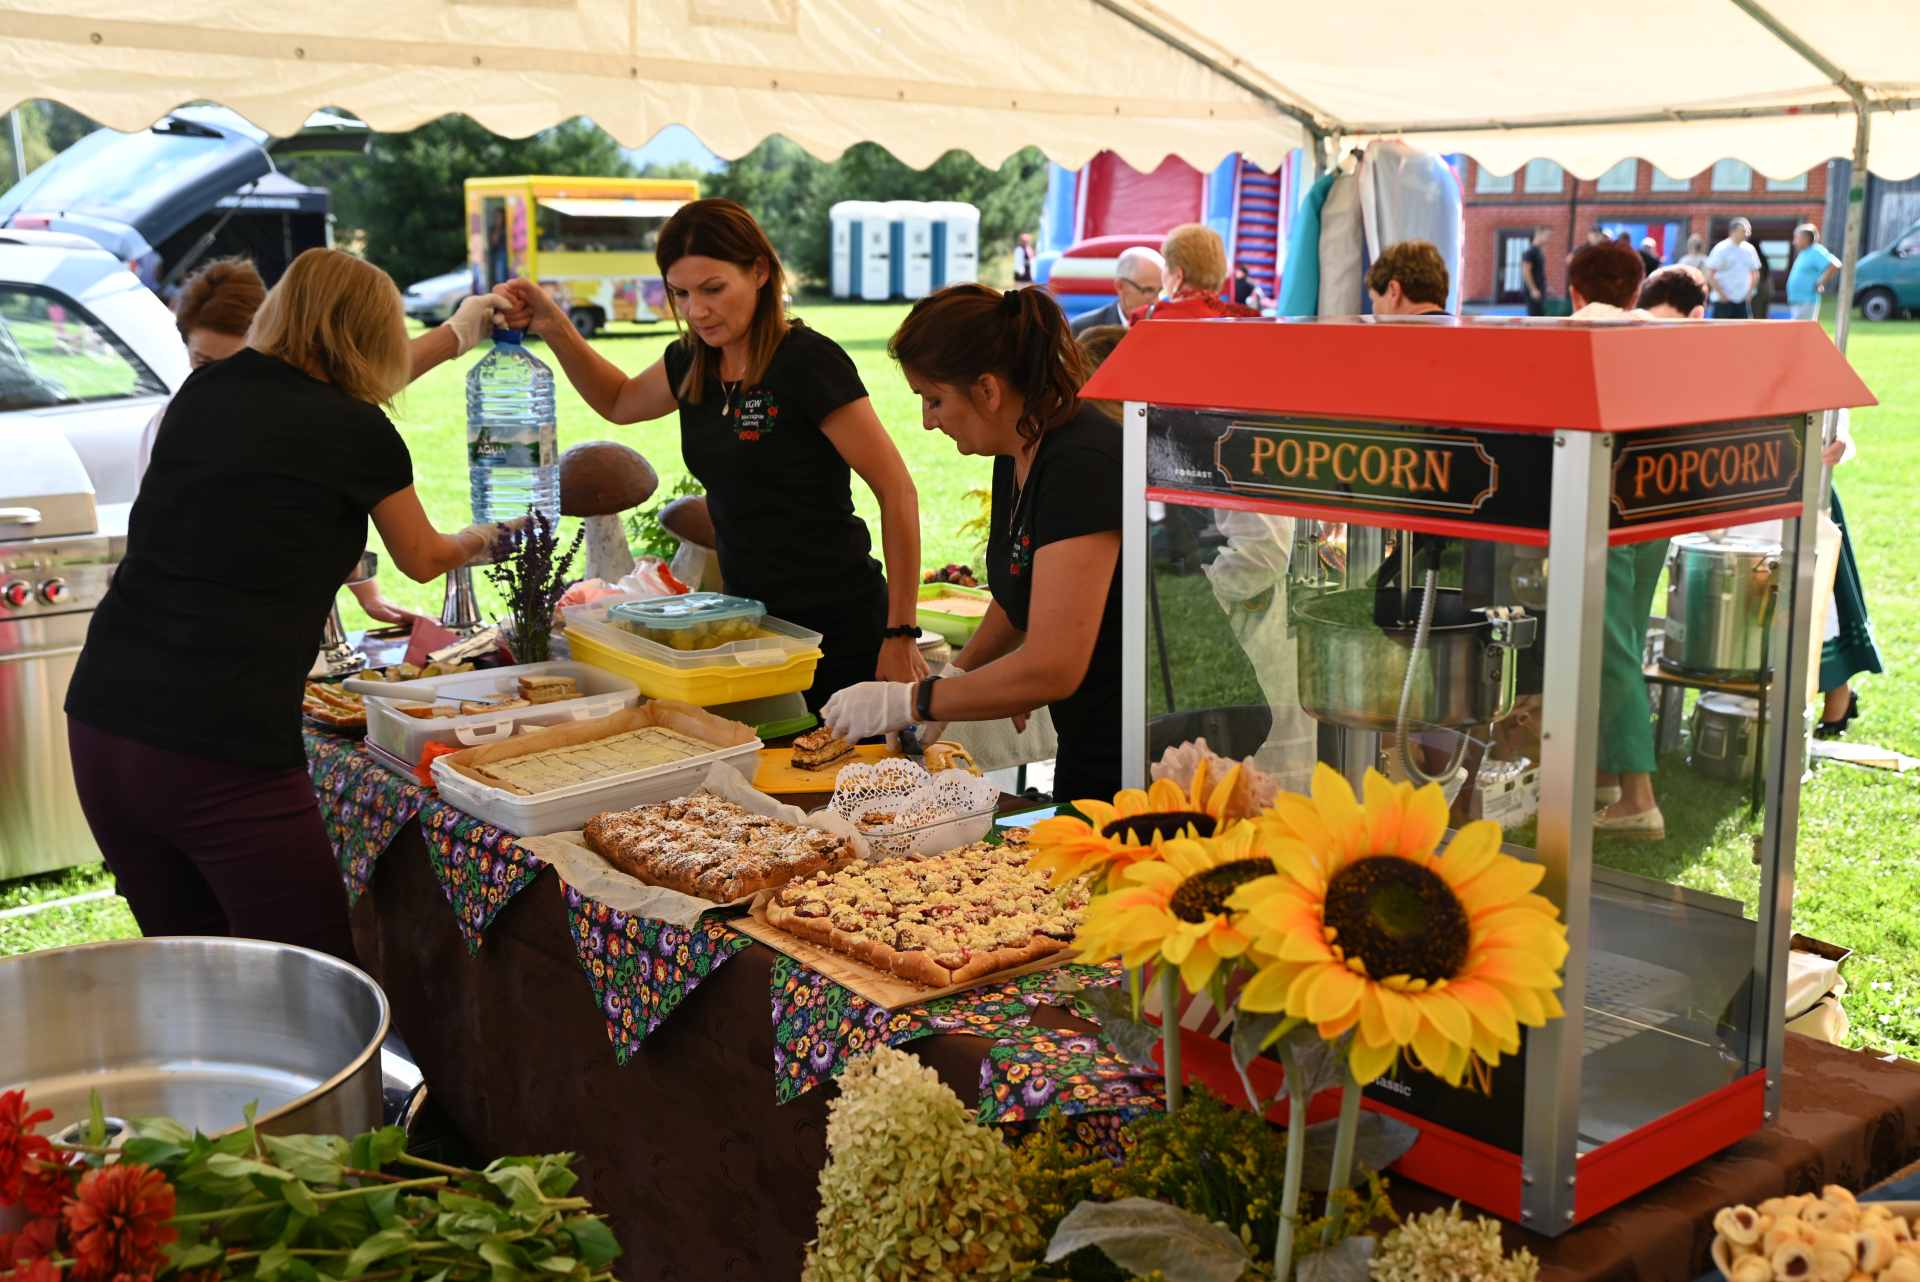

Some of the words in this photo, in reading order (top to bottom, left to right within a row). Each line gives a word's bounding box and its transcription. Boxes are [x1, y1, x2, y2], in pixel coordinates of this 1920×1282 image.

[477, 444, 505, 454] AQUA
[1250, 436, 1453, 492] POPCORN
[1635, 439, 1783, 497] POPCORN
[1376, 1077, 1411, 1096] lassic
